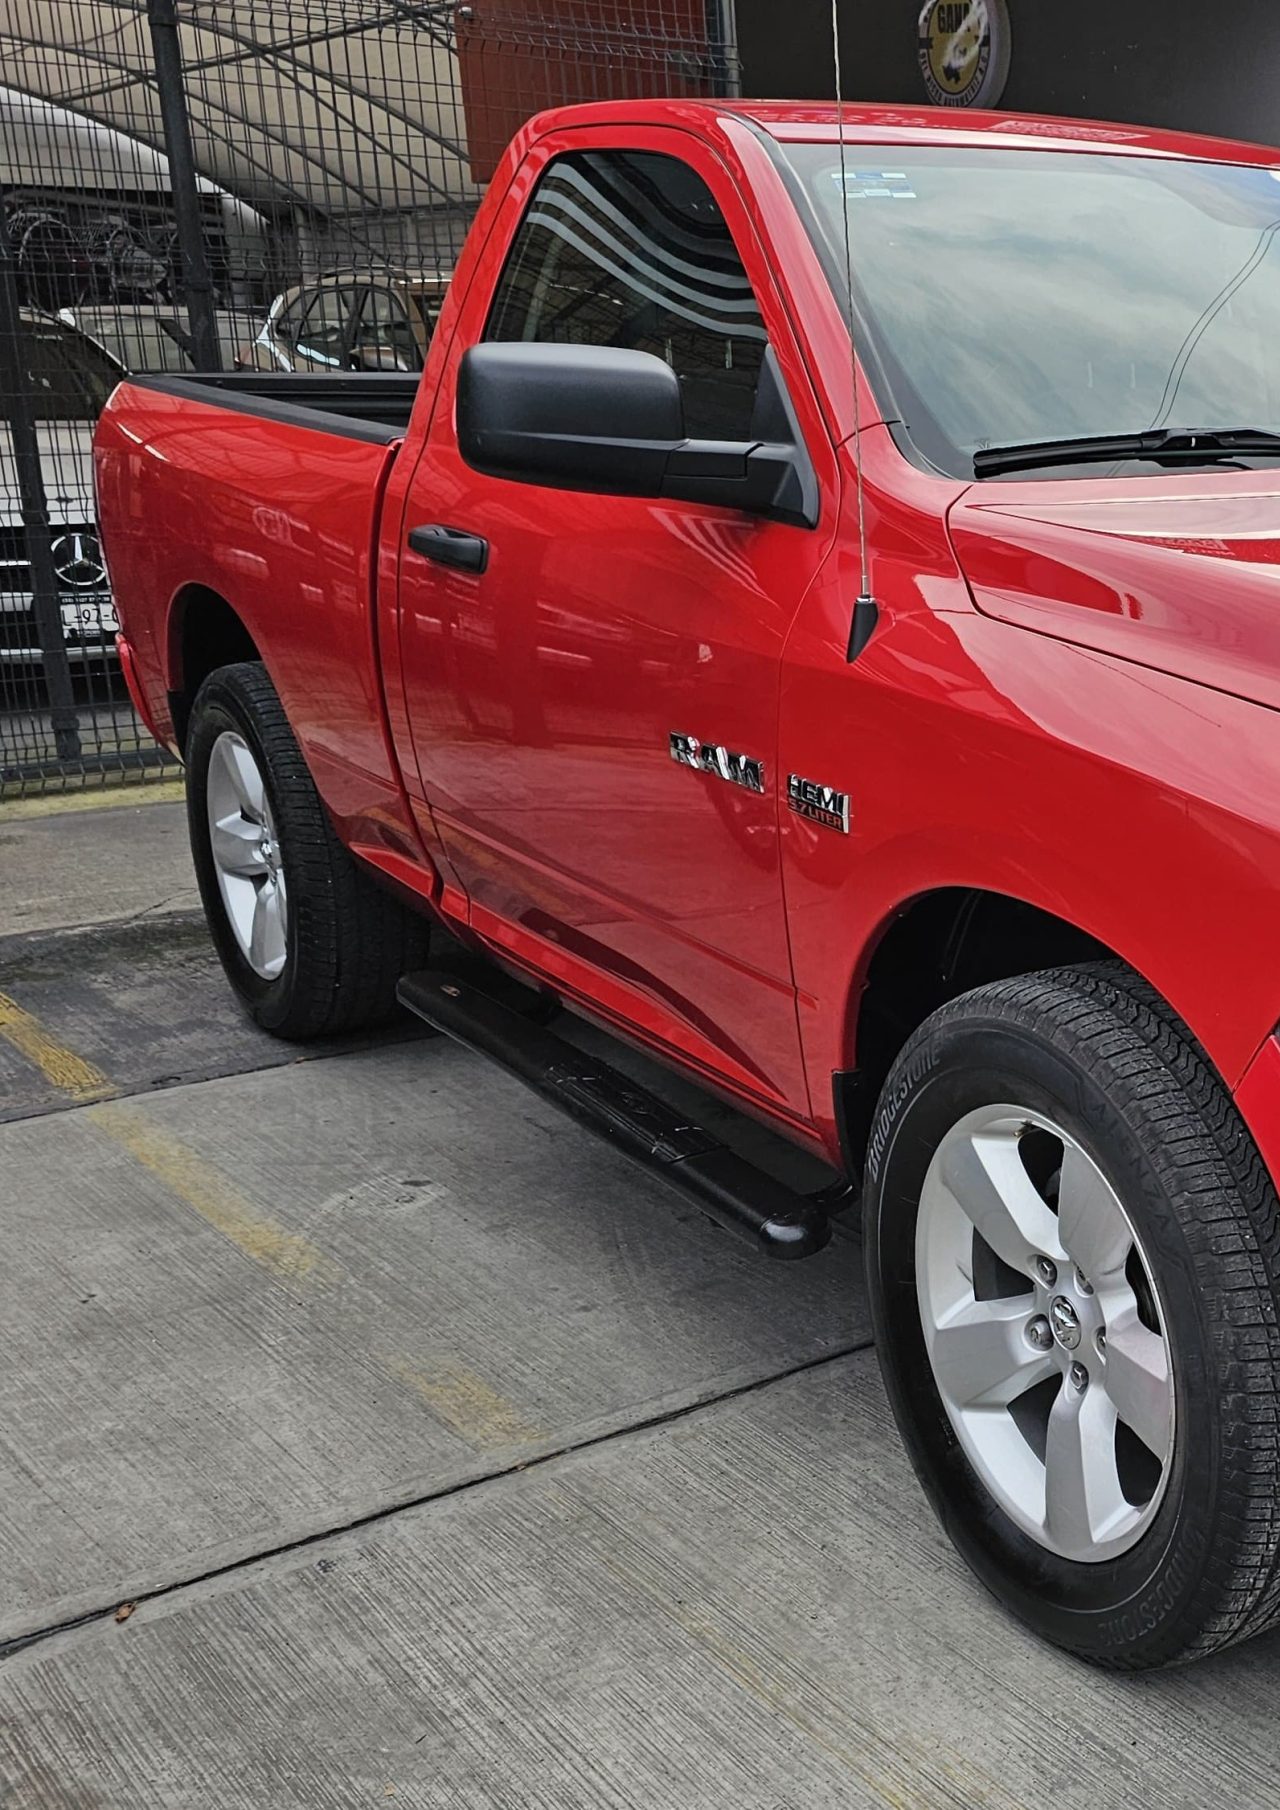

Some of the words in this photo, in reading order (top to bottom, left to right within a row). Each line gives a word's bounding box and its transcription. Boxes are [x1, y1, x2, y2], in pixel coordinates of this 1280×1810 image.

[670, 730, 764, 793] RAM
[787, 772, 850, 817] HEMI
[808, 804, 843, 830] LITER
[866, 1043, 941, 1185] BRIDGESTONE
